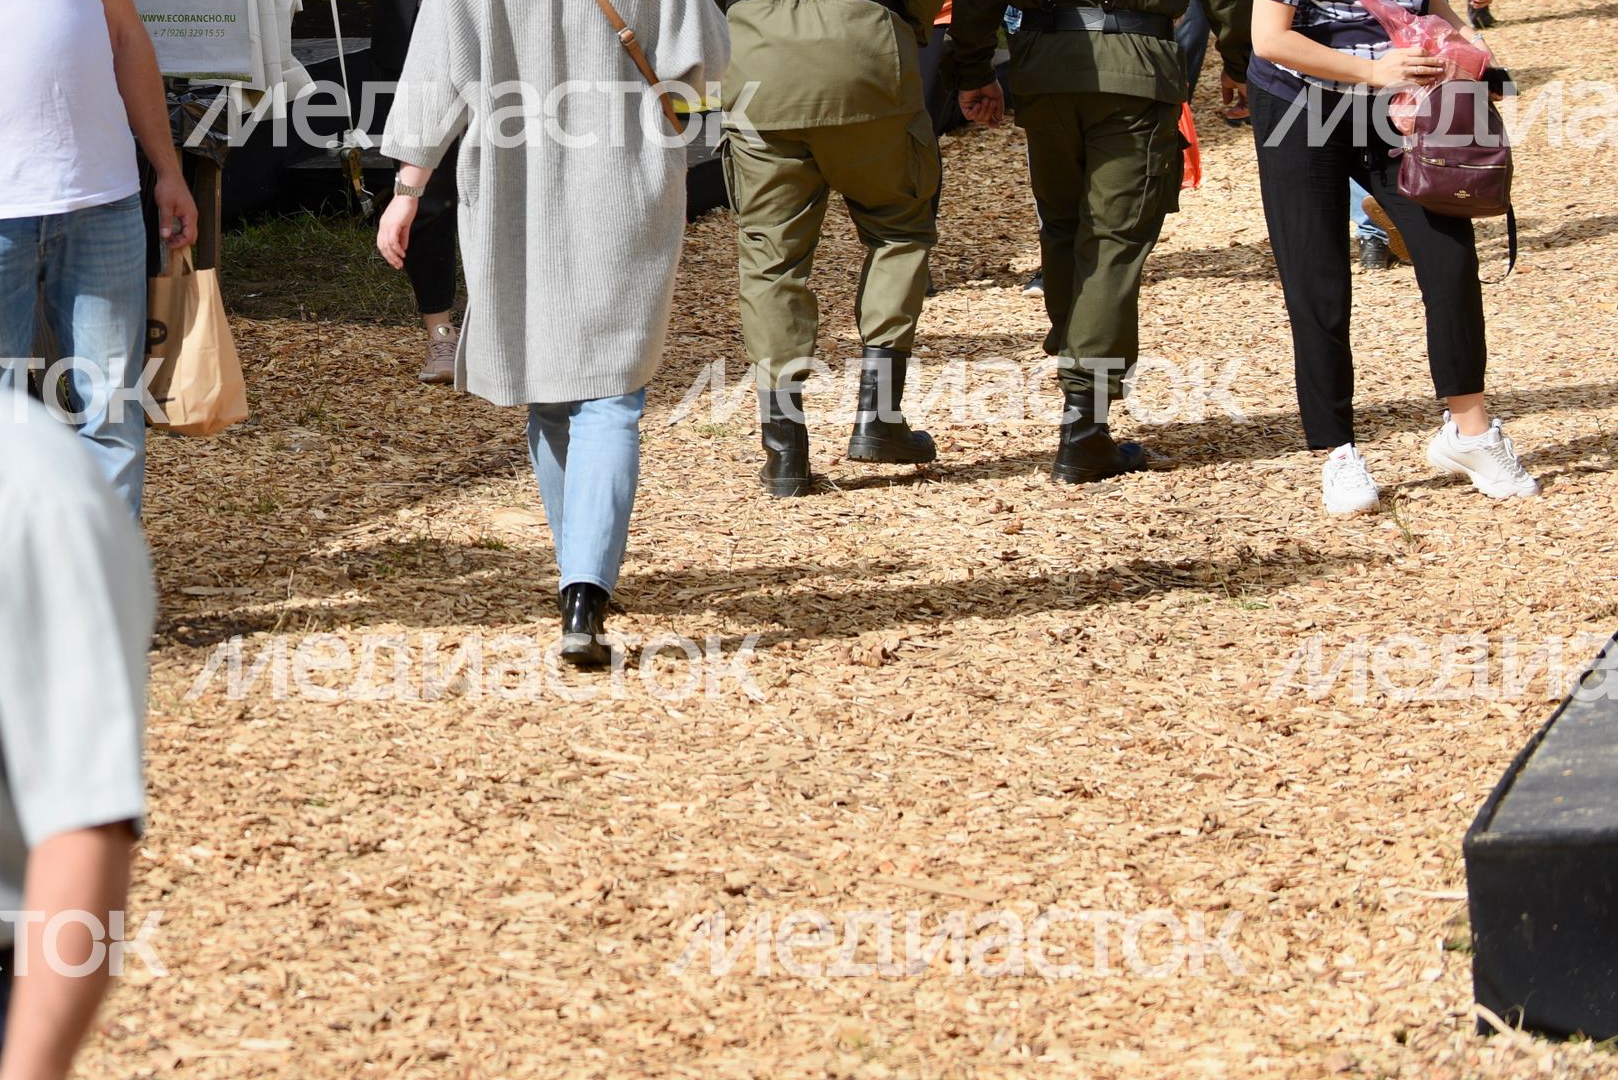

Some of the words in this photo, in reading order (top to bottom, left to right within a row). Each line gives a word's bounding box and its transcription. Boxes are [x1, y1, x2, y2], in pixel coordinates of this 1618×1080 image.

[161, 28, 166, 36] 7
[167, 27, 187, 39] (926)
[189, 28, 203, 37] 329
[205, 28, 214, 37] 15
[216, 28, 226, 37] 55
